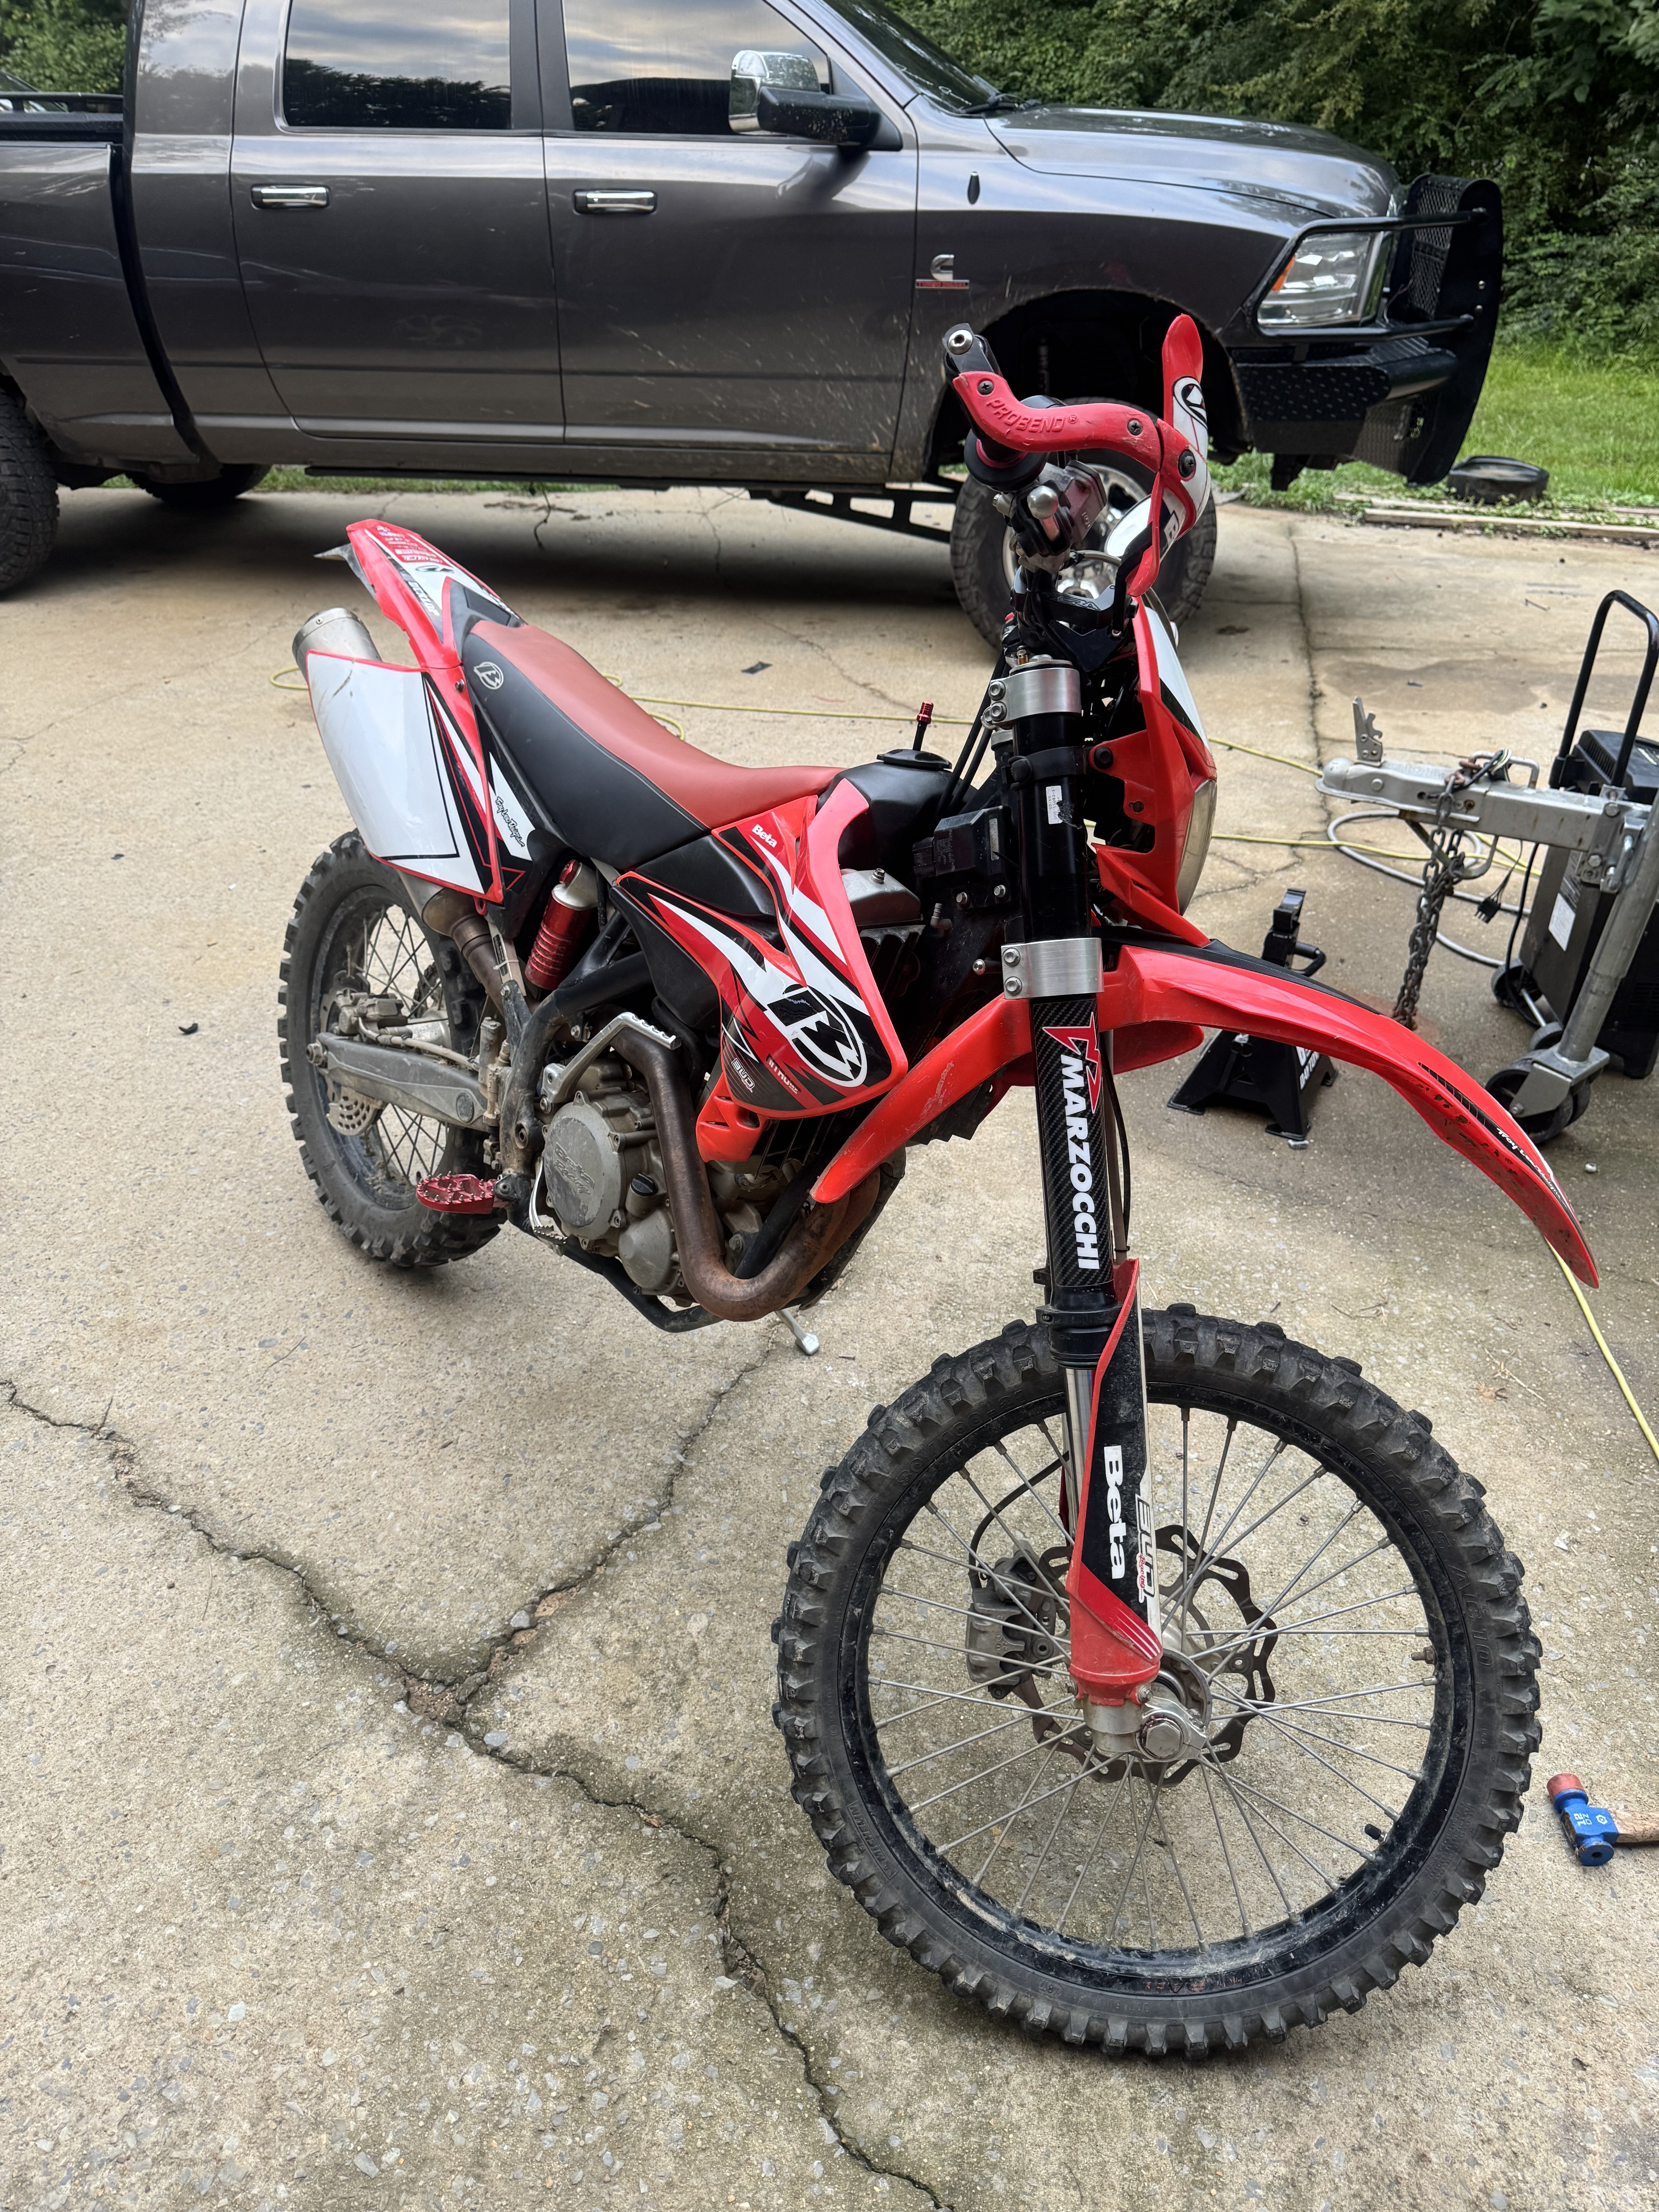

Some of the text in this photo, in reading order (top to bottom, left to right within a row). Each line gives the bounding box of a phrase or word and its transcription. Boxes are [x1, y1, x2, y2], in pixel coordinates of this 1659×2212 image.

[752, 824, 777, 848] Beta
[1060, 1054, 1100, 1270] MARZOCCHI
[1103, 1444, 1127, 1579] Beta
[847, 1804, 888, 1864] MICHELIN
[1574, 1813, 1584, 1826] 12
[1582, 1813, 1592, 1825] OZ
